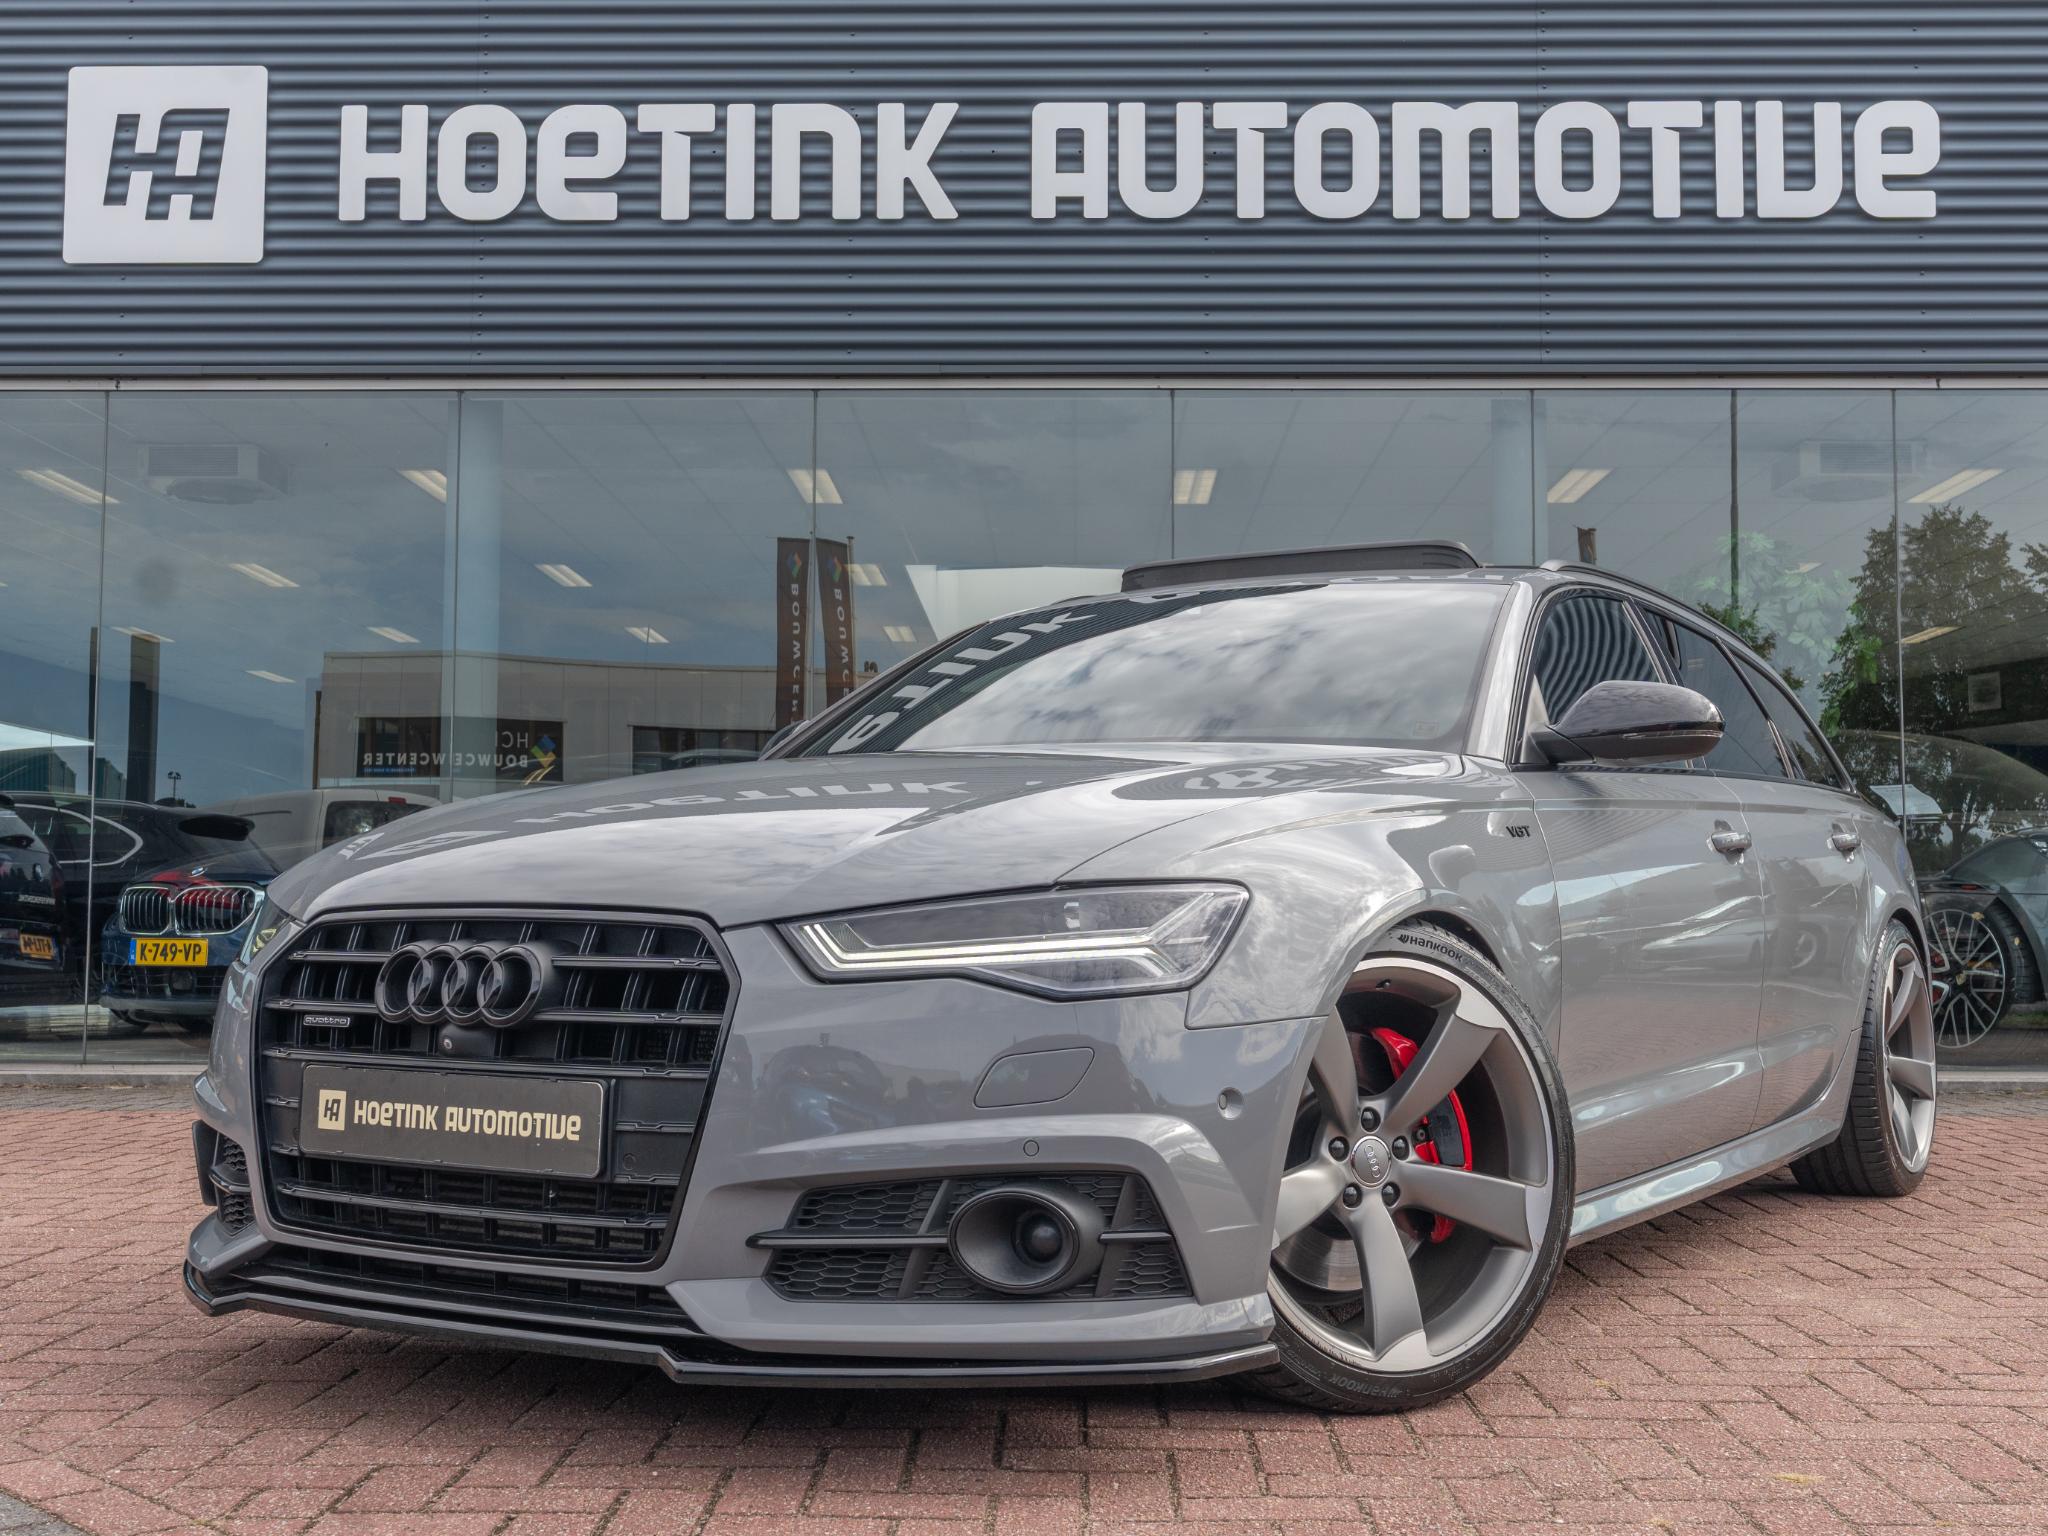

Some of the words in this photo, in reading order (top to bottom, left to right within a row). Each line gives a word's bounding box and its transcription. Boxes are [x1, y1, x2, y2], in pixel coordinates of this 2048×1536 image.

[1030, 100, 1941, 219] AUTOMOTIVE
[140, 942, 202, 962] K-749-VP
[305, 1016, 347, 1025] quattro
[445, 1106, 581, 1142] AUTOMOTIVE
